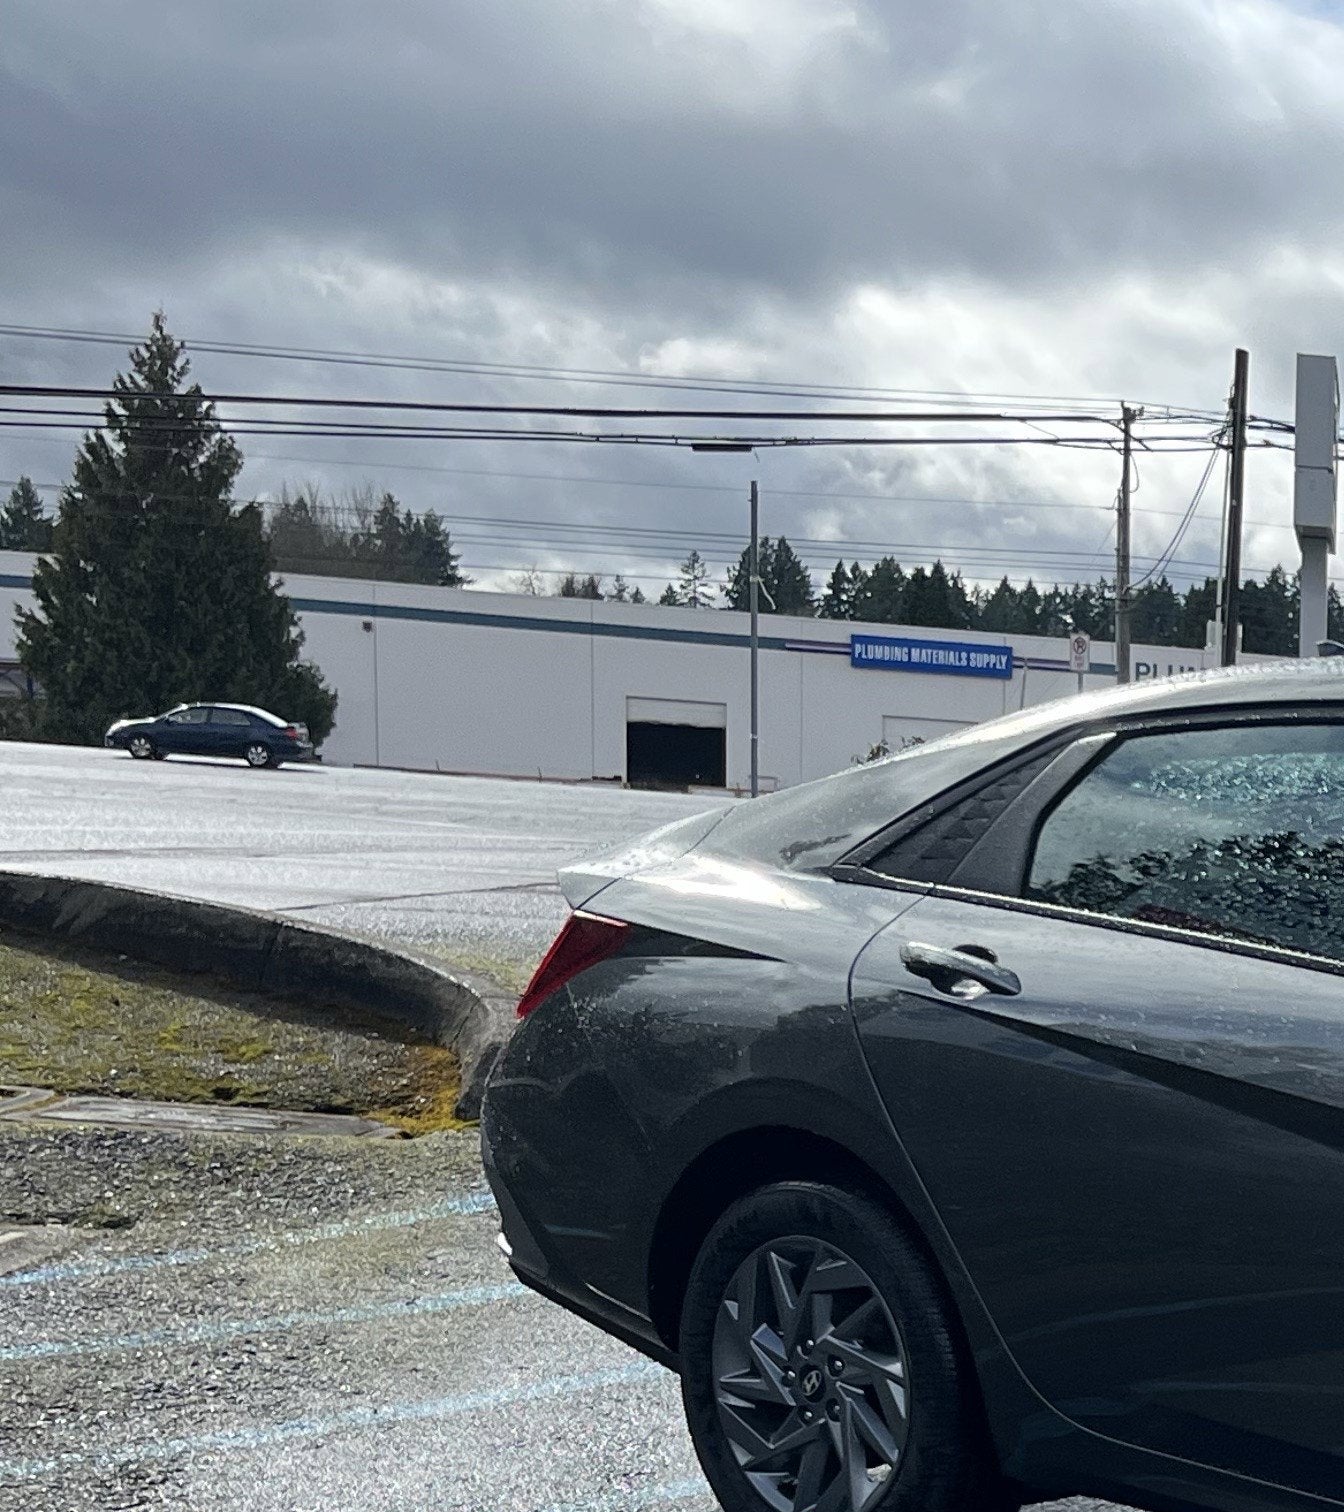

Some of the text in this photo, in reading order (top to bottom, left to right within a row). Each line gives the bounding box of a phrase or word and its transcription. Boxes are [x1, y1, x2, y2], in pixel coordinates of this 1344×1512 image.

[854, 643, 1008, 669] PLUMBING MATERIALS SUPPLY
